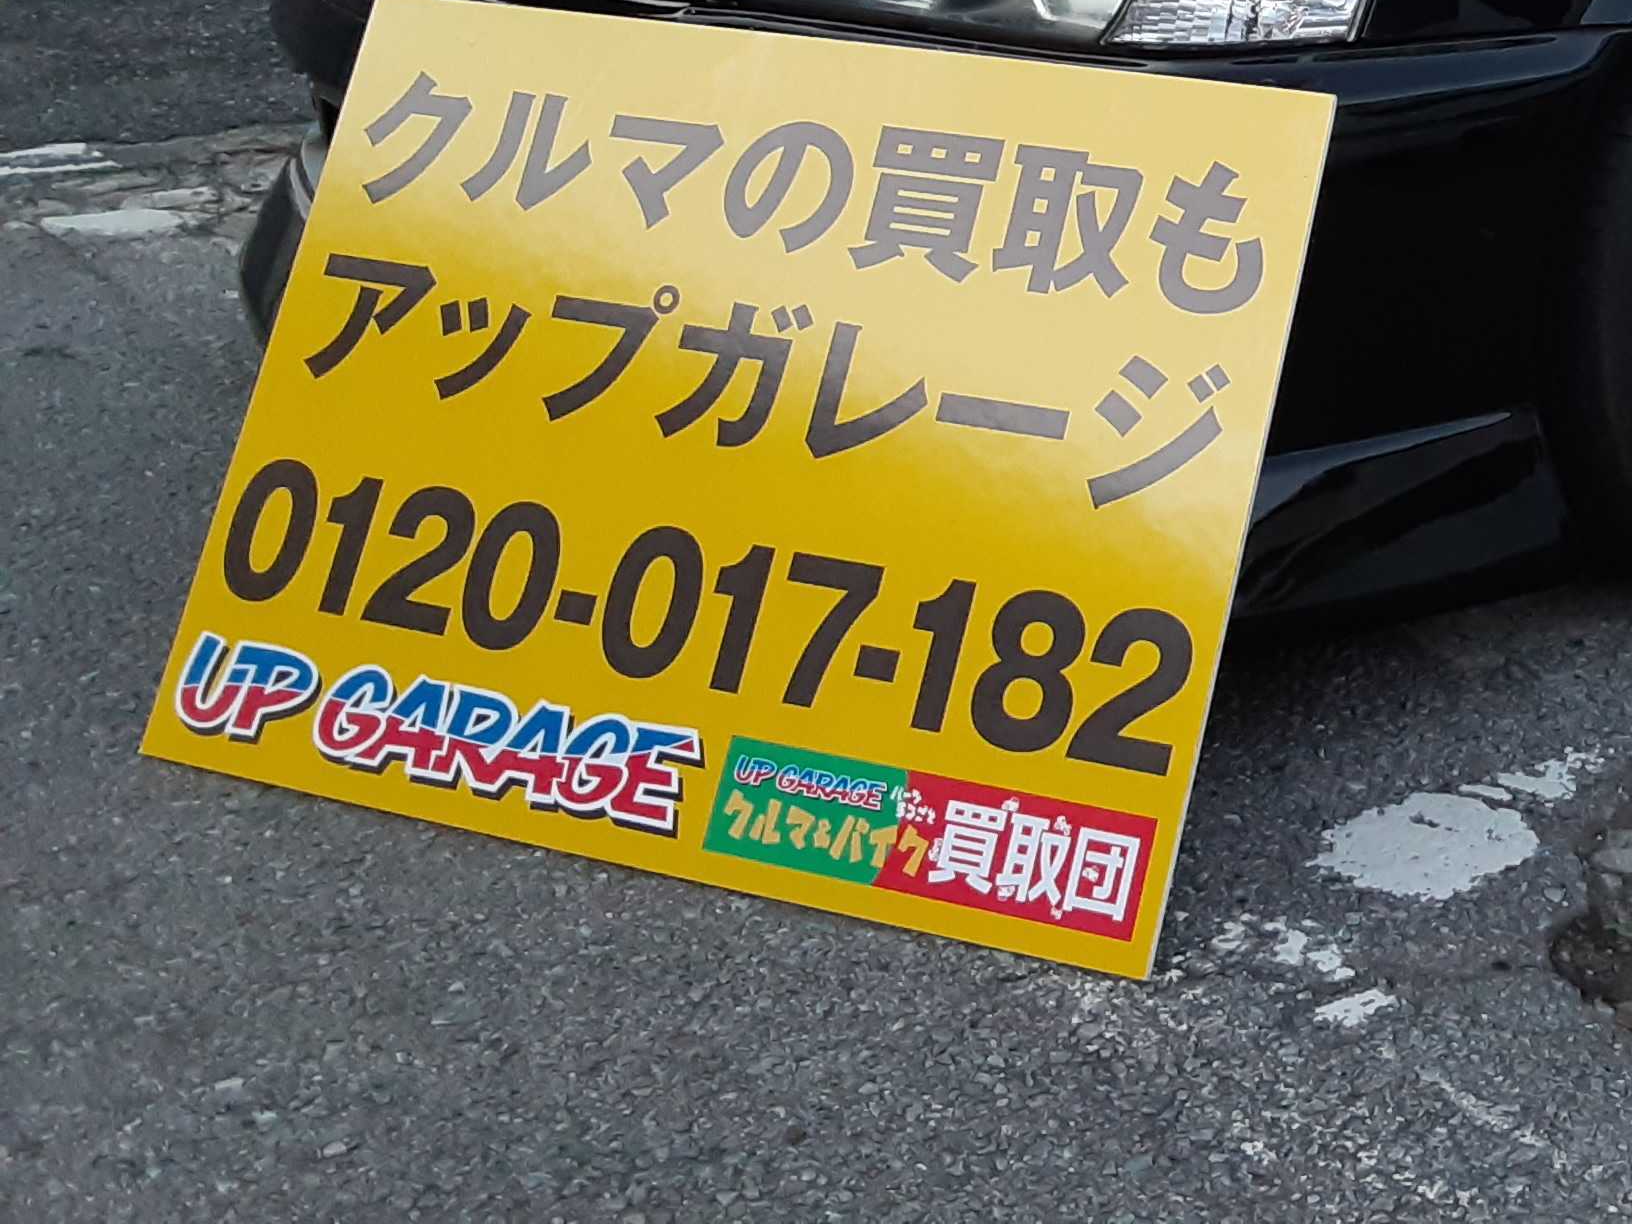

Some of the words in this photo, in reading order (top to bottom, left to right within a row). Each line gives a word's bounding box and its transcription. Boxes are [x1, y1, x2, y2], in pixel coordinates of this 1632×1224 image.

[361, 70, 1264, 314] クルマの買取も
[303, 252, 1229, 510] アップガレージ
[222, 457, 1195, 776] 0120-017-182
[175, 631, 321, 744] UP
[312, 664, 704, 838] GARAGE
[734, 754, 777, 786] UP
[775, 764, 888, 811] GARAGE
[928, 799, 1141, 922] 買取団
